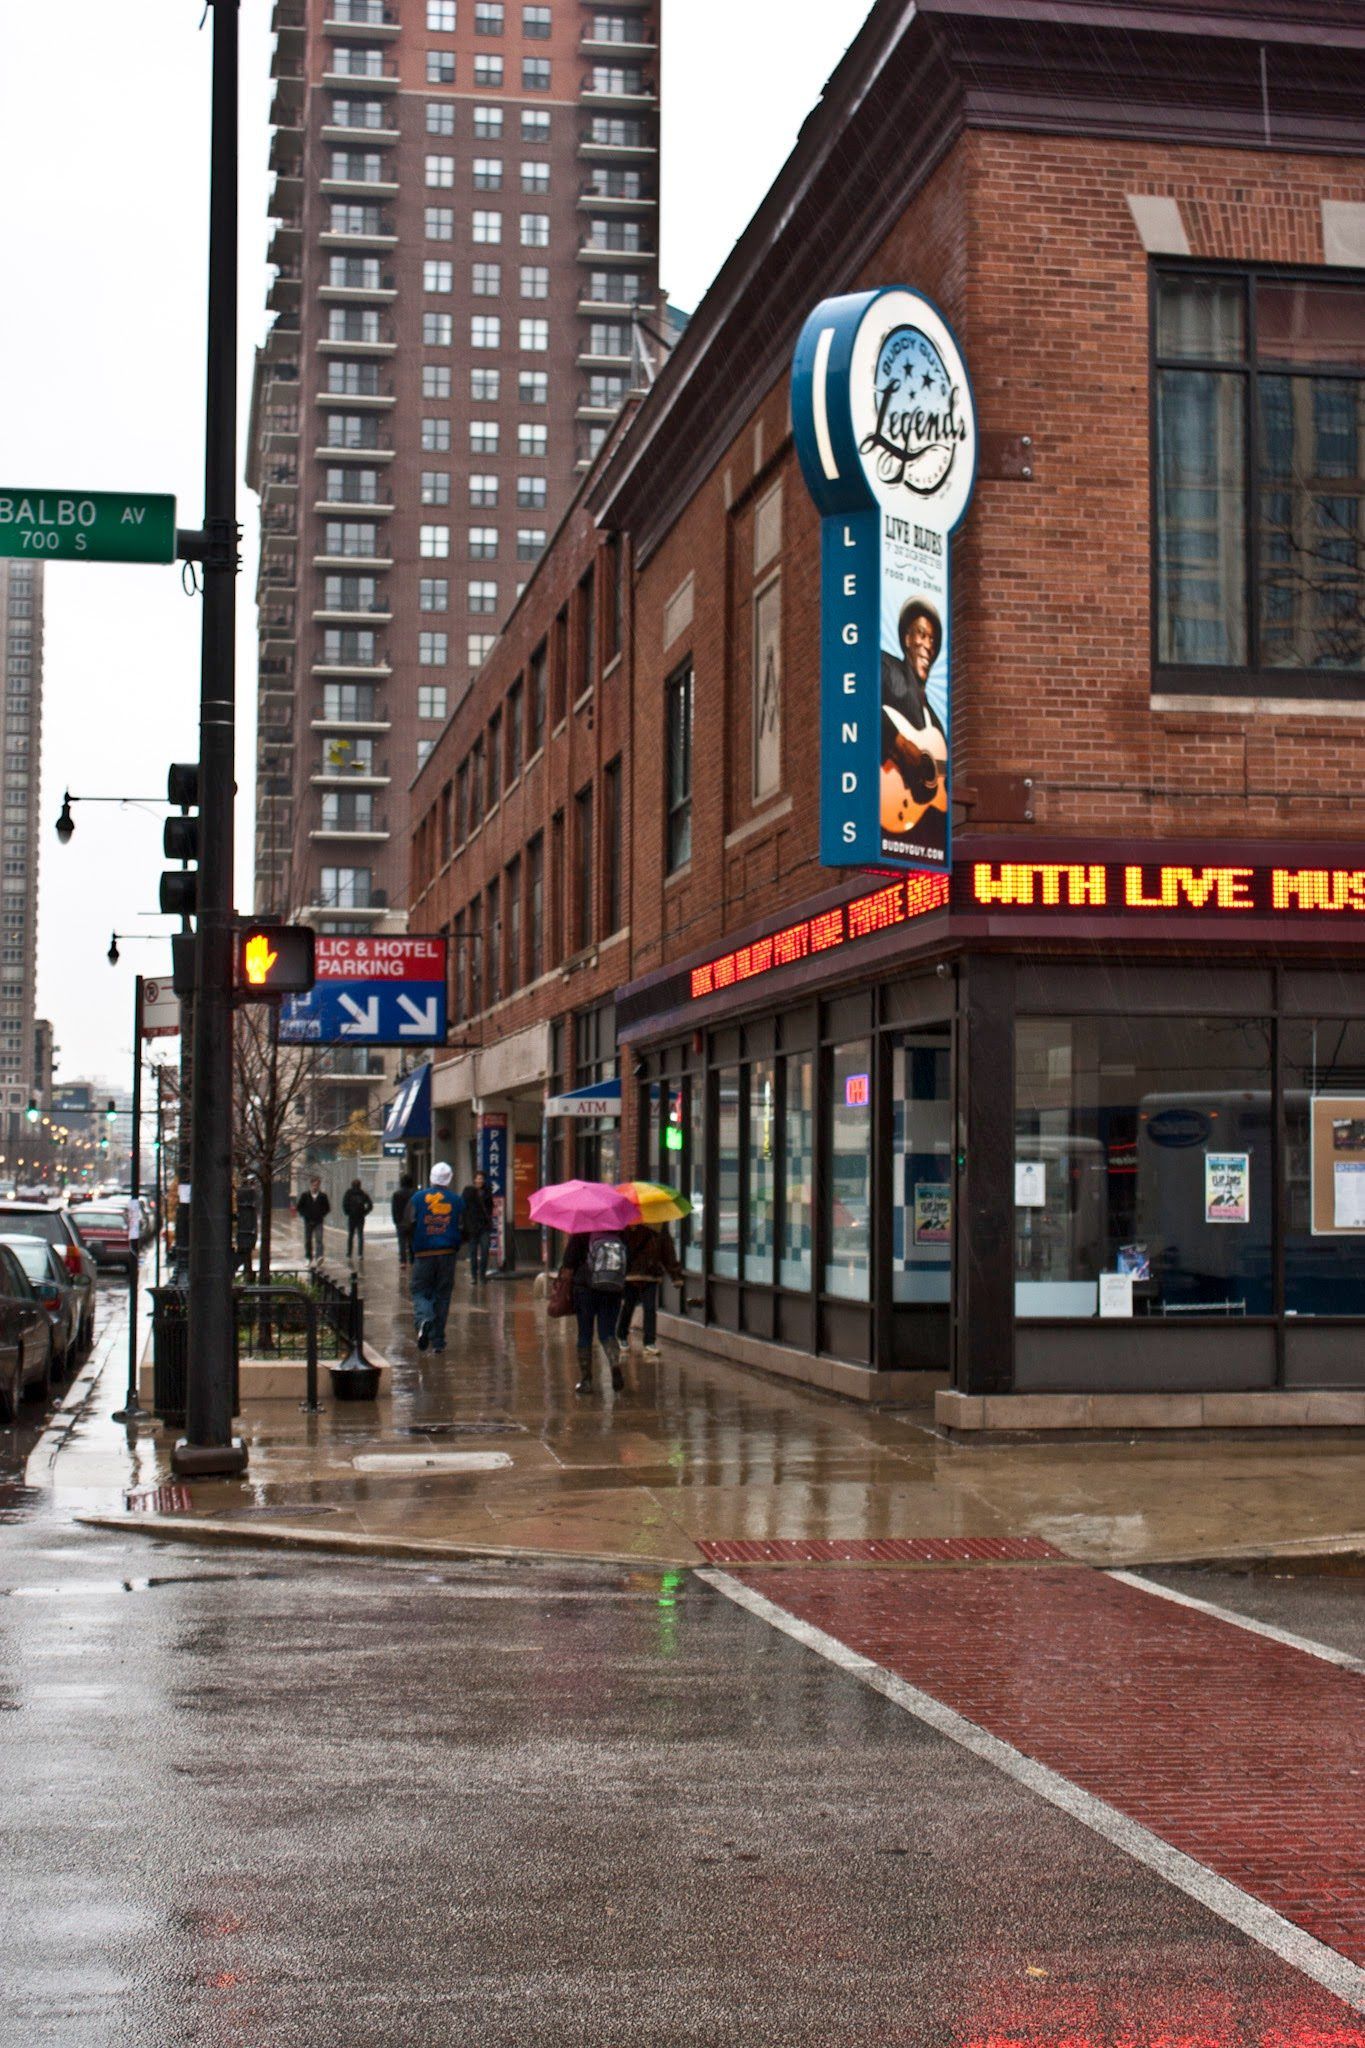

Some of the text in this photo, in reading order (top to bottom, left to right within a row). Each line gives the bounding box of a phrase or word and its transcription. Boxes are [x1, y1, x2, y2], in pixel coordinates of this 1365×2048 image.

[859, 379, 967, 484] Legends
[0, 497, 146, 526] BALBO AV
[20, 531, 88, 551] 700 S
[885, 514, 909, 545] LIVE
[841, 526, 859, 844] LEGENDS
[881, 839, 945, 861] BUDDYGUY.COM
[974, 863, 1106, 904] WITH
[1125, 866, 1254, 907] LIVE
[355, 941, 368, 957] &
[374, 941, 439, 958] HOTEL
[318, 959, 405, 976] PARKING
[577, 1101, 608, 1113] ATM
[489, 1130, 500, 1177] PARK
